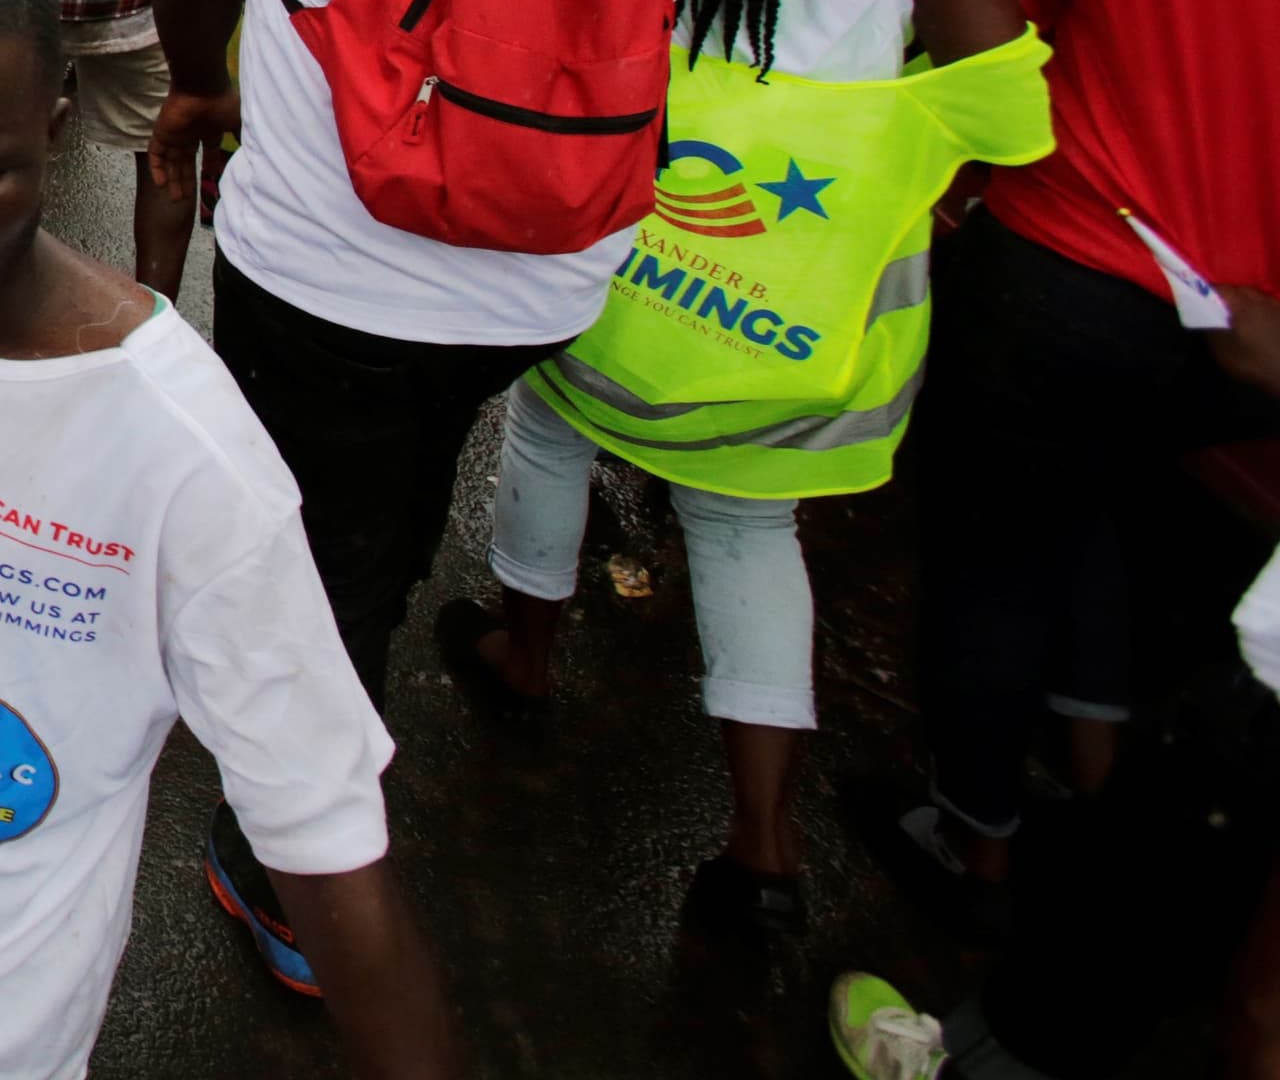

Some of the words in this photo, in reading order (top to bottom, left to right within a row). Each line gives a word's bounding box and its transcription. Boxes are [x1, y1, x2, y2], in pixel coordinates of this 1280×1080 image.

[749, 281, 769, 302] B.
[643, 296, 675, 318] YOU
[679, 314, 710, 336] CAN
[715, 333, 765, 360] TRUST
[50, 522, 136, 563] TRUST
[30, 601, 62, 619] US
[71, 612, 101, 626] AT
[12, 764, 37, 786] C
